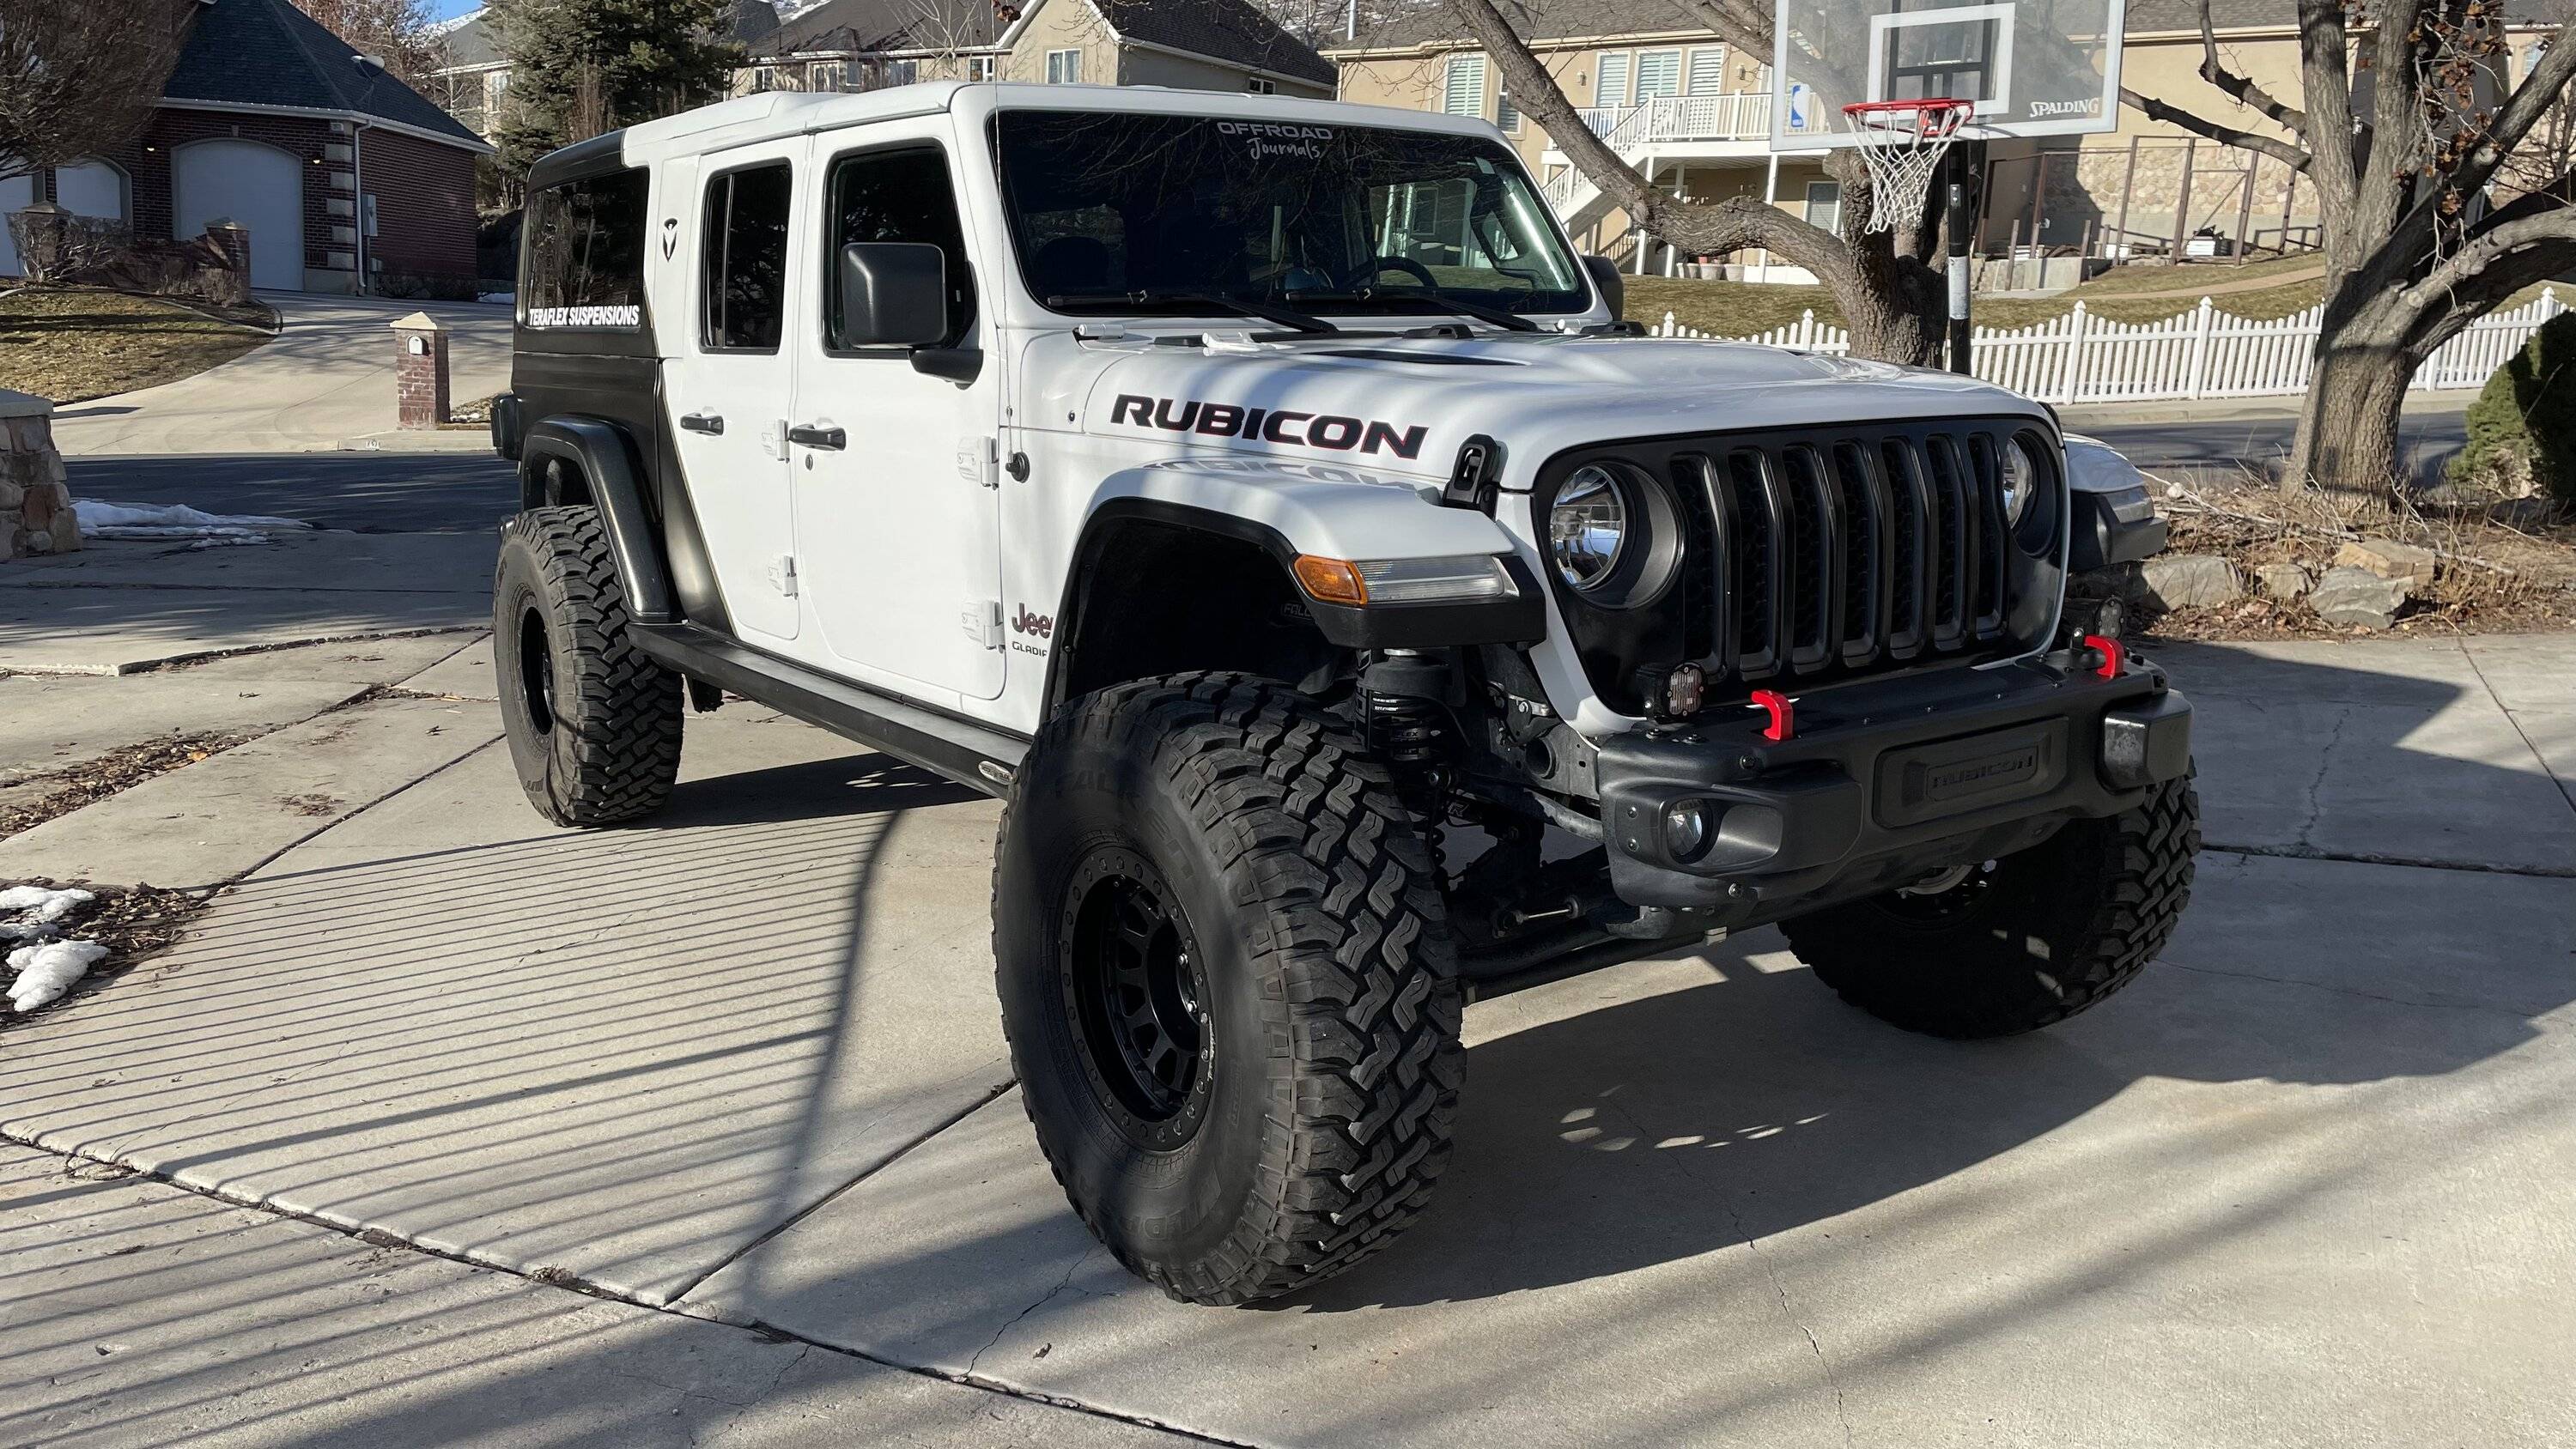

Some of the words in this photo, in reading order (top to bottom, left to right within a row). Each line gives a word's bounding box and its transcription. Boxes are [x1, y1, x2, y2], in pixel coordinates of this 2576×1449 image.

[2029, 97, 2099, 118] SPALDING
[1216, 122, 1334, 140] OFFROAD
[1246, 137, 1321, 161] Journals
[529, 307, 568, 326] TERAFLEX
[568, 305, 640, 325] SUSPENSIONS
[1109, 393, 1430, 461] RUBICON
[1012, 640, 1048, 658] GLADIA
[1932, 755, 2033, 788] RUBICON
